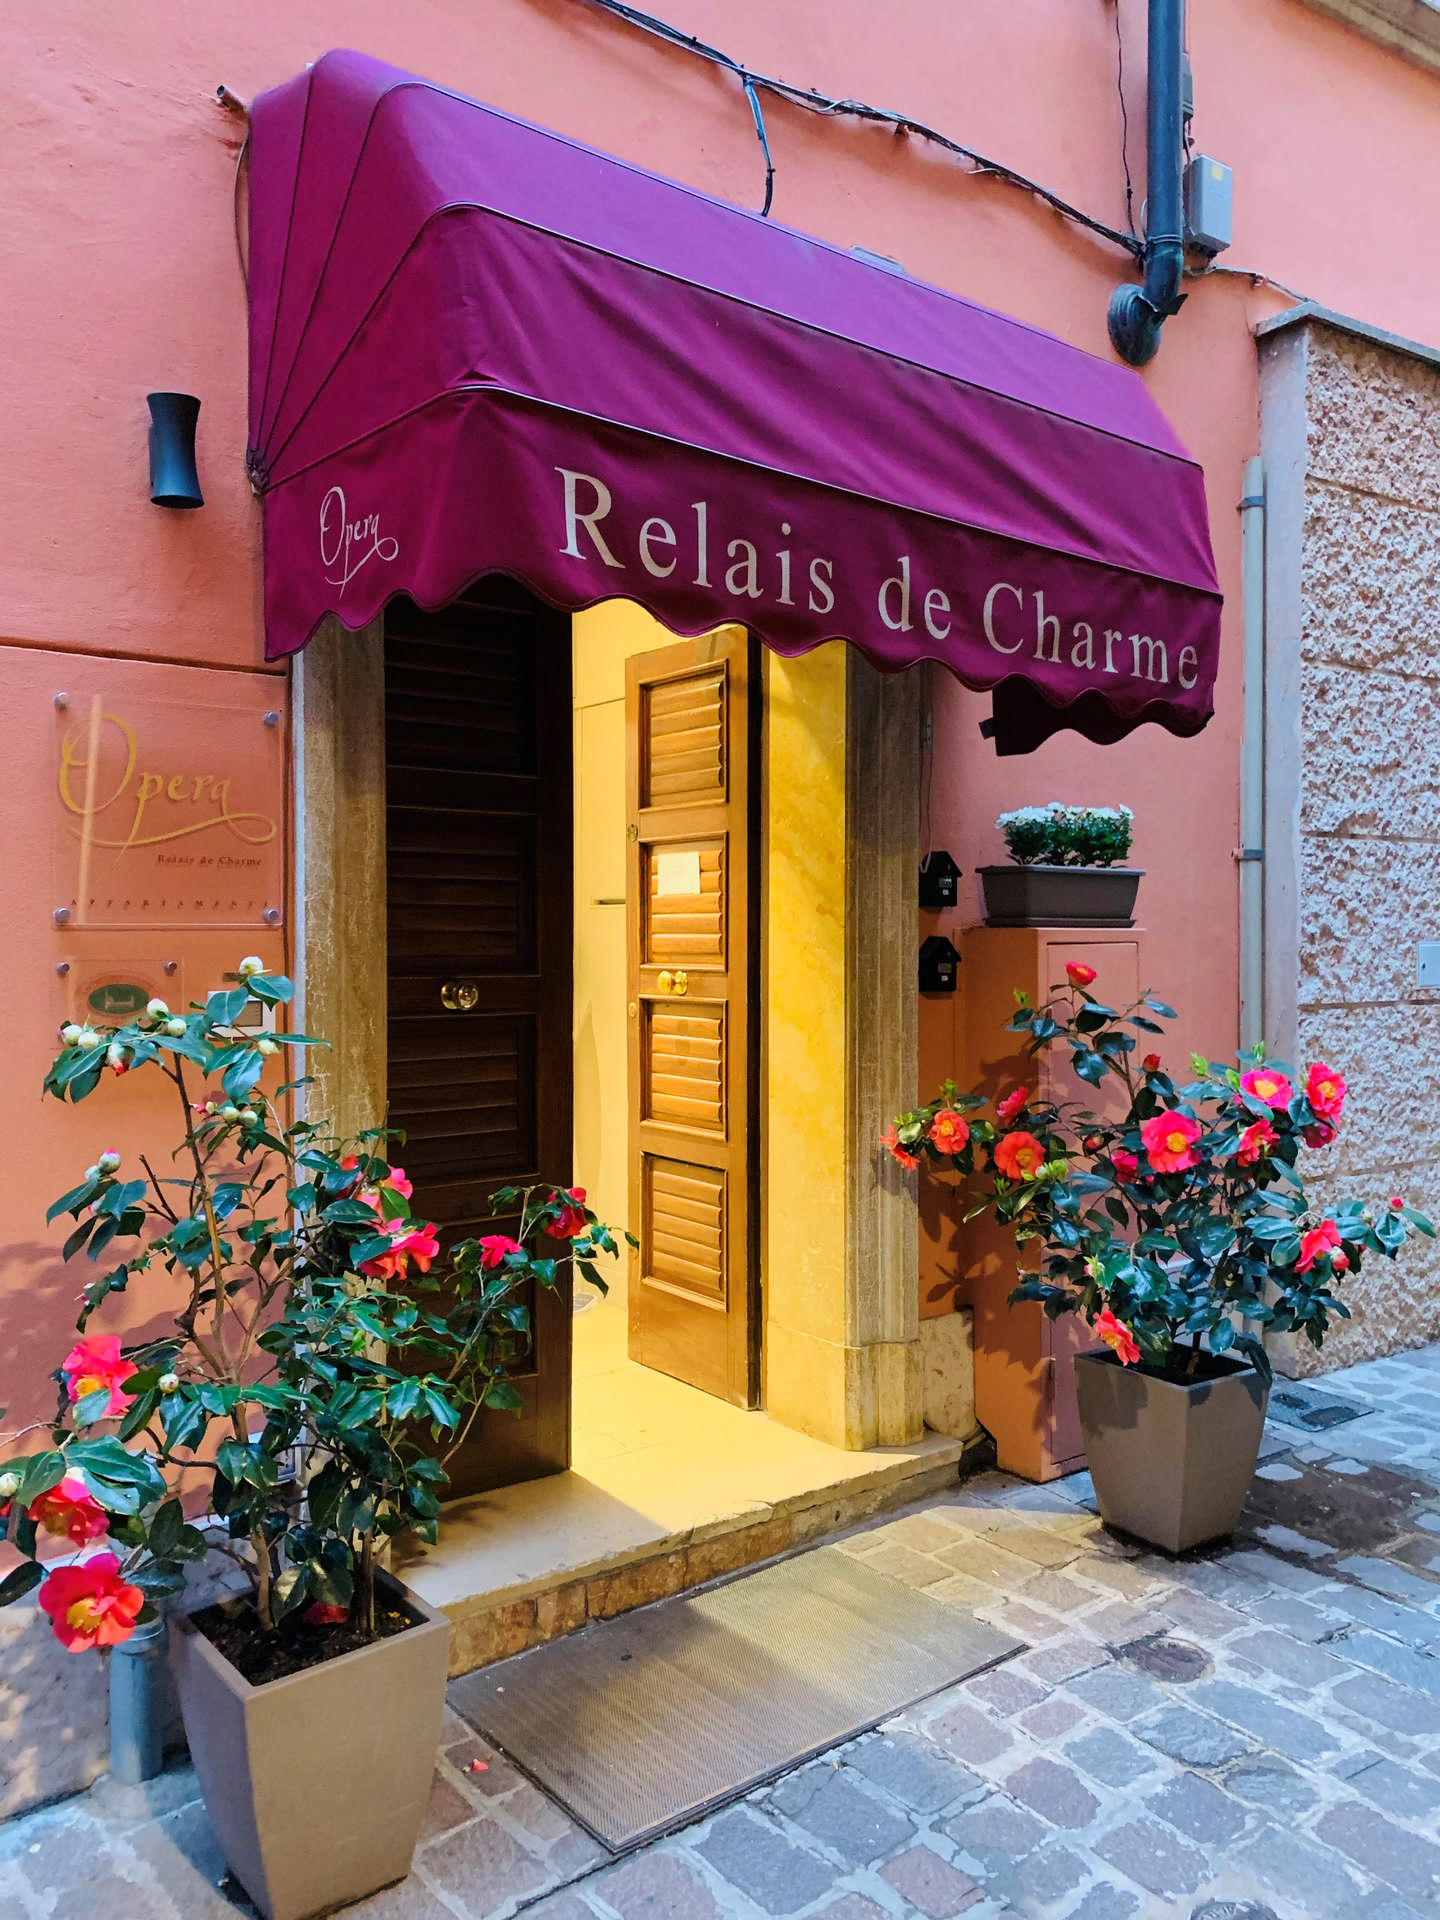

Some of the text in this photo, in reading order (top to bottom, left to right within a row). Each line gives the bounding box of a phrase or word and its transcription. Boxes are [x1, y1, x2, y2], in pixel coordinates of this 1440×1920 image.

[320, 486, 399, 601] Opera
[554, 466, 1199, 690] Relais de Charme
[59, 711, 277, 869] Opera
[200, 856, 214, 866] de
[219, 856, 262, 867] Charme
